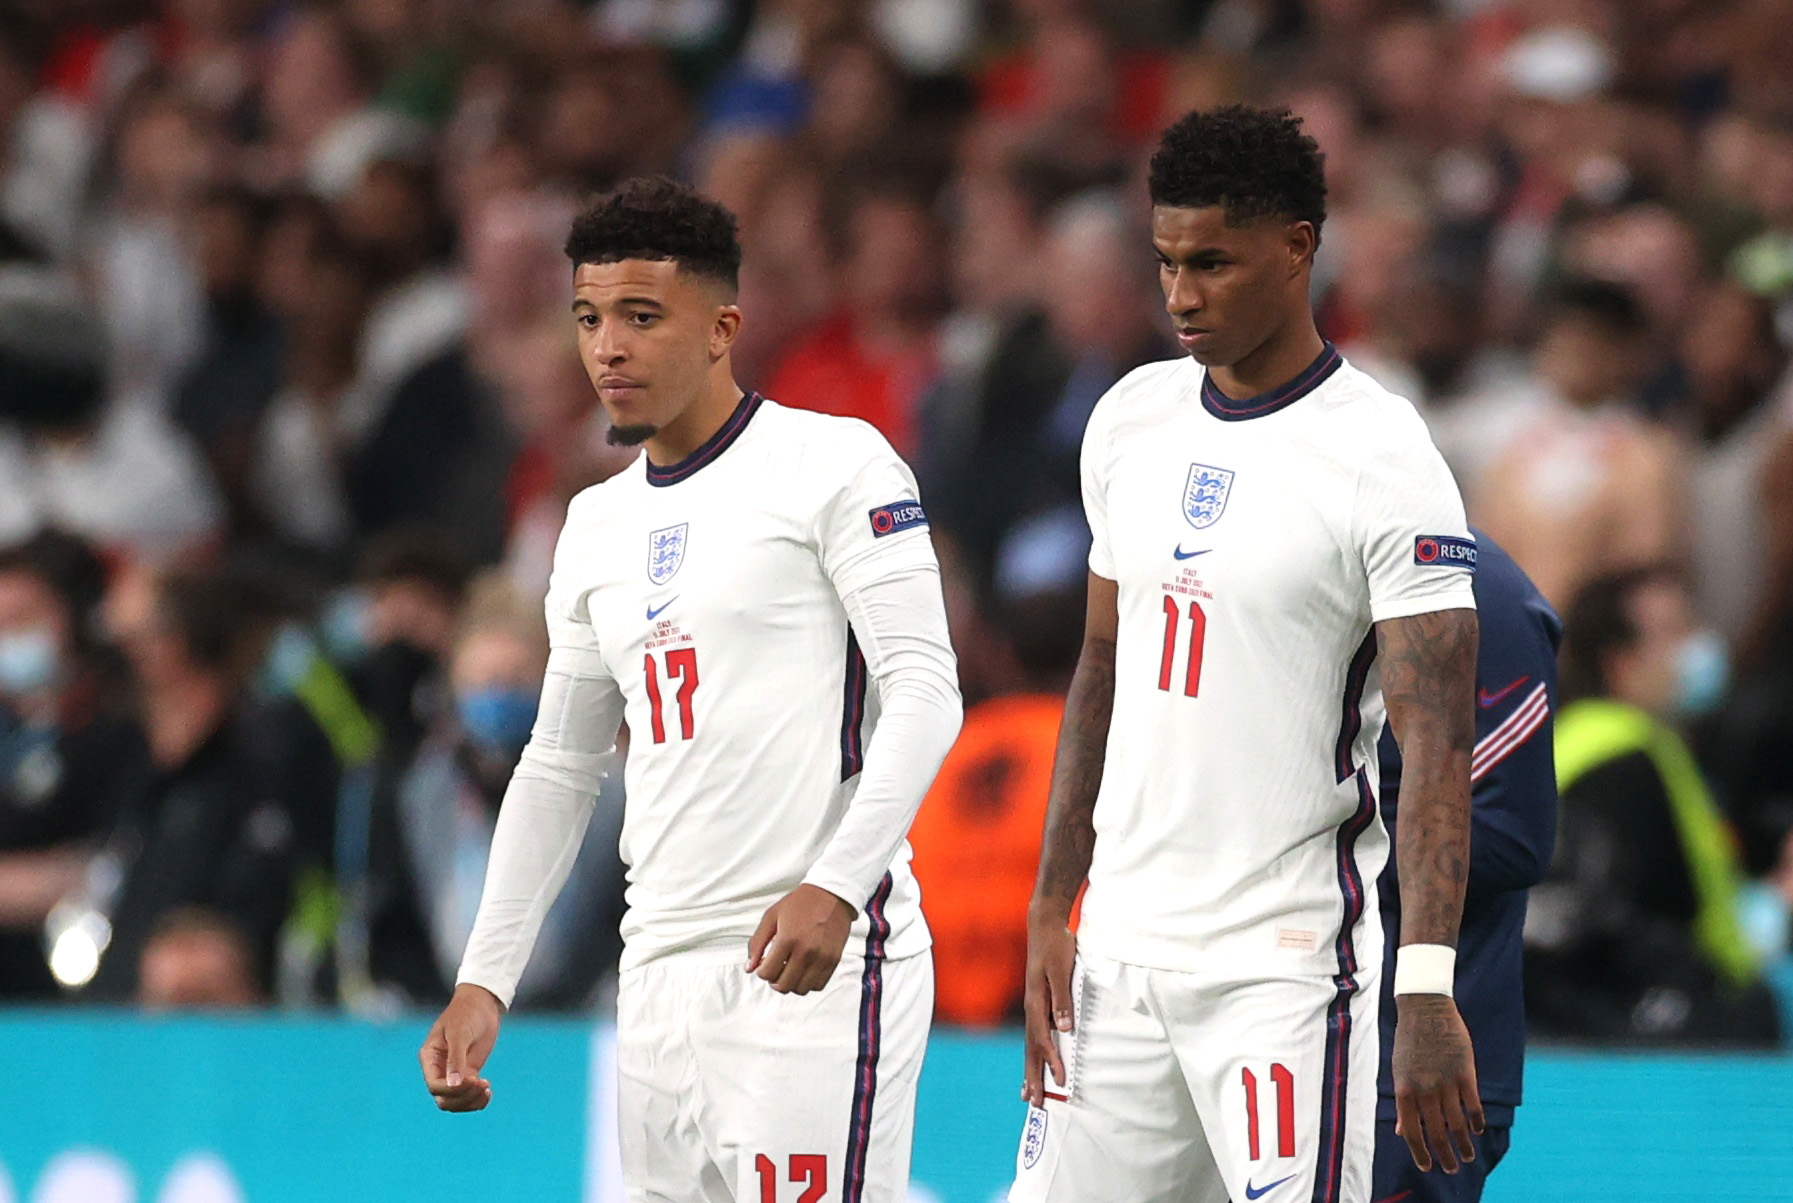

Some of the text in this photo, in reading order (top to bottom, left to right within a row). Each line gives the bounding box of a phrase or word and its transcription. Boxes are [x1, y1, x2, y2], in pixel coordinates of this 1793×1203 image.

[892, 506, 926, 524] RESPEC
[1158, 594, 1206, 698] 11
[643, 647, 699, 744] 17
[1241, 1062, 1295, 1161] 11
